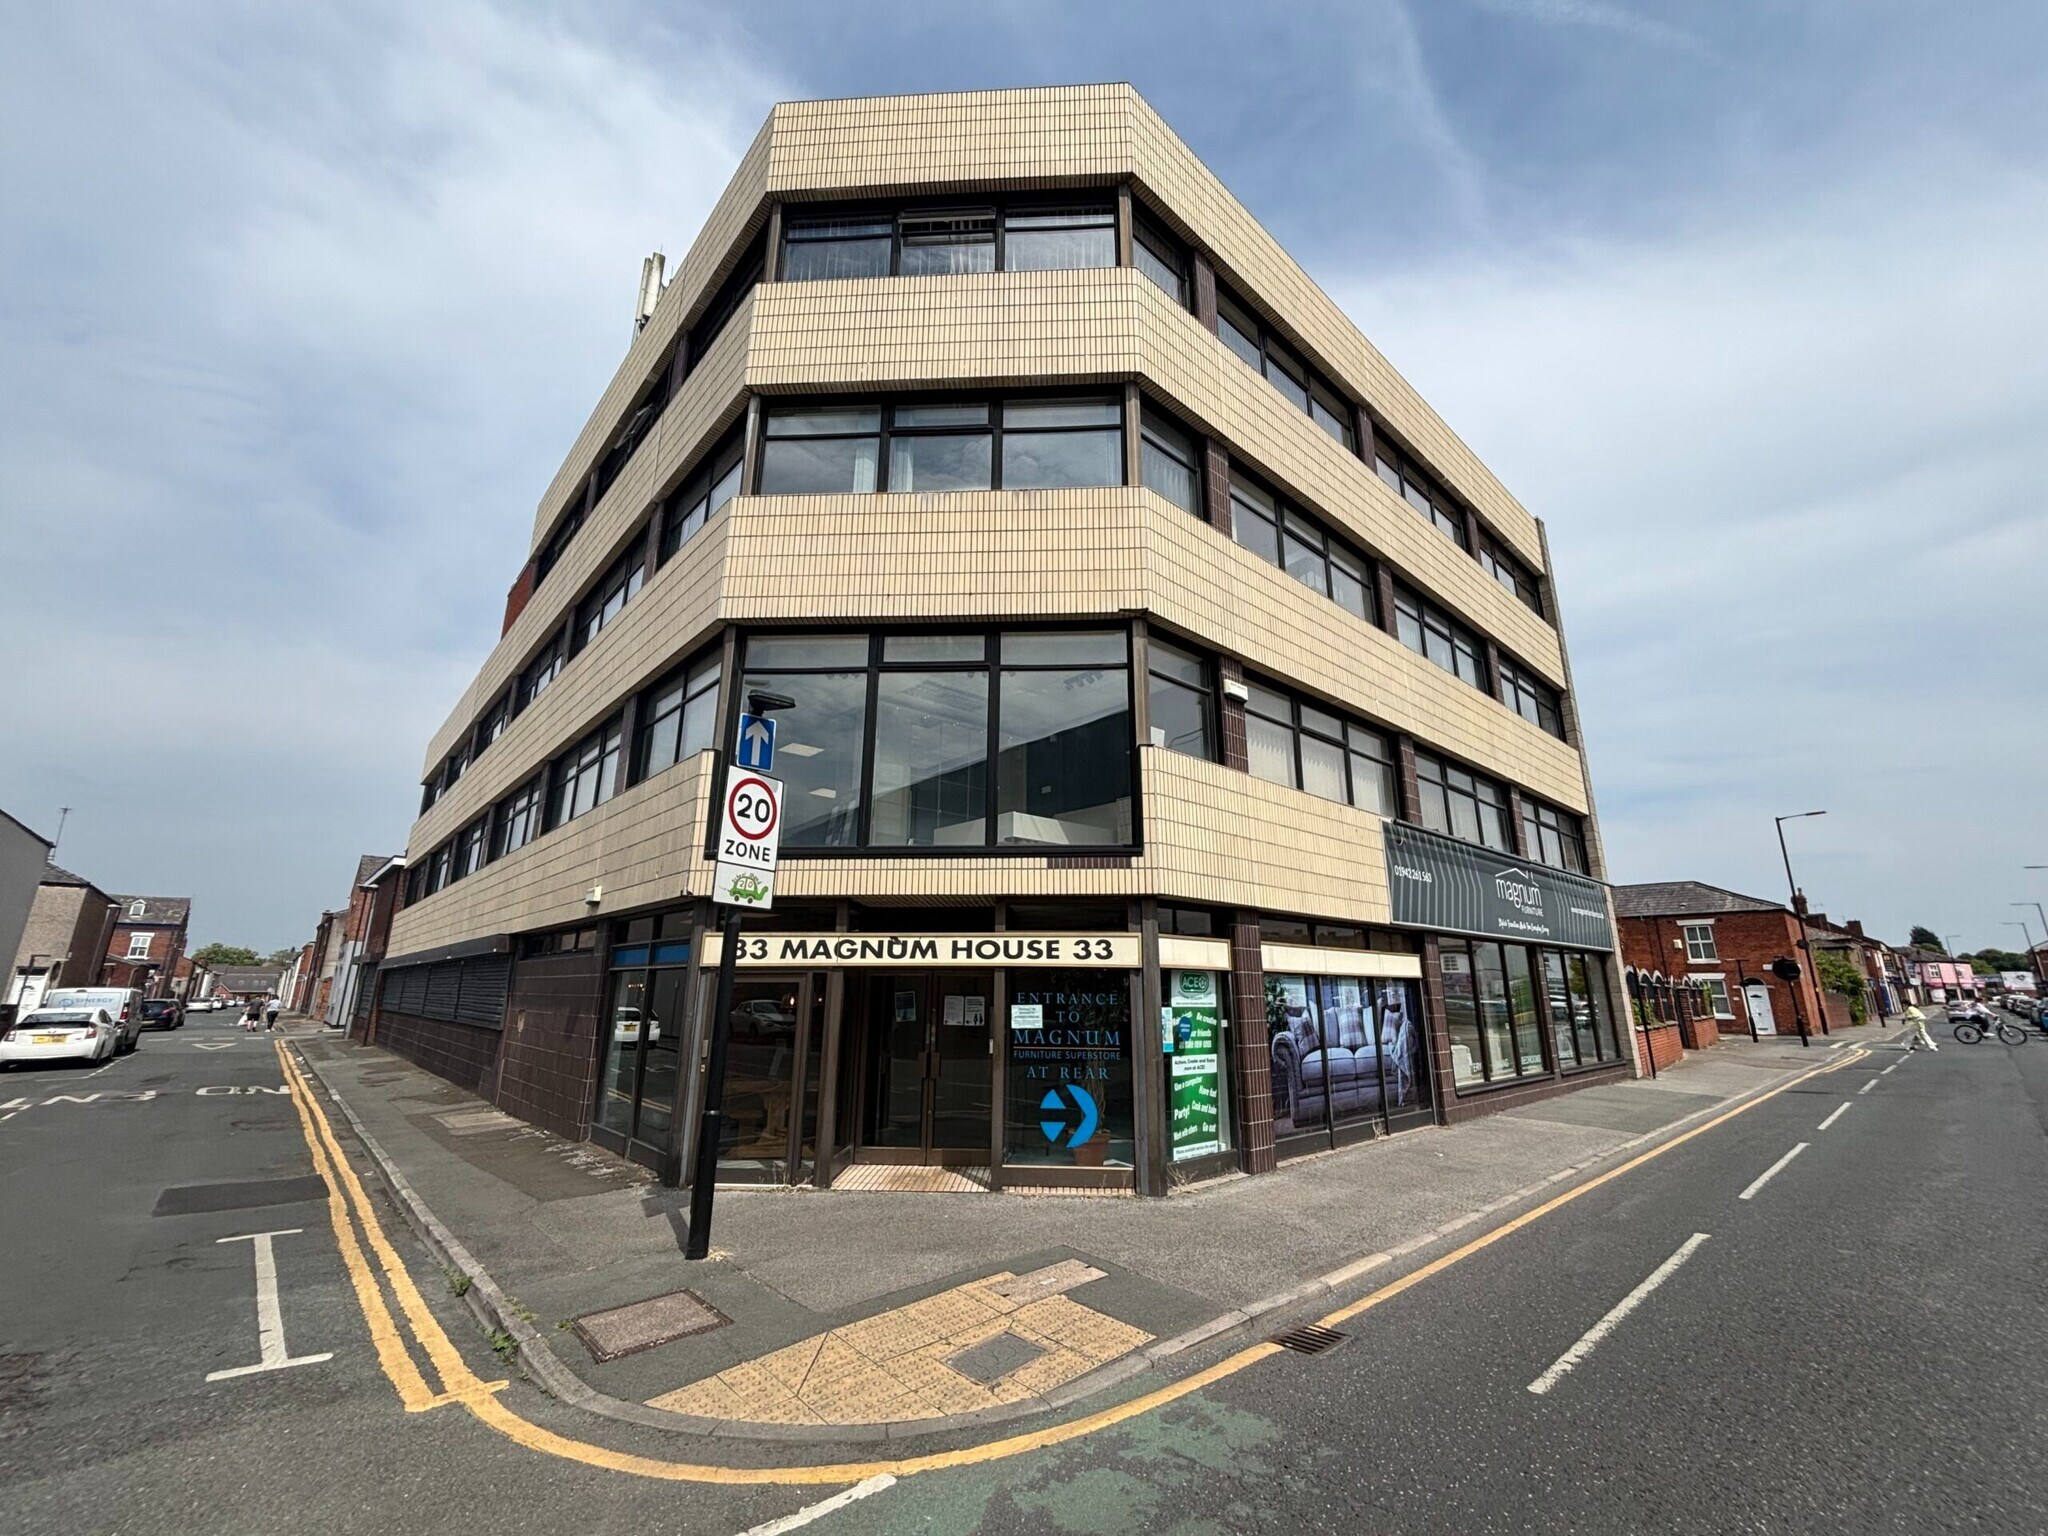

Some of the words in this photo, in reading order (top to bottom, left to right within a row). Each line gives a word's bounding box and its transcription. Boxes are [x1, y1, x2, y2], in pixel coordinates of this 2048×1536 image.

[737, 793, 770, 823] 20
[725, 839, 771, 862] ZONE
[1496, 879, 1542, 908] magnum
[780, 938, 938, 960] MAGNUM
[951, 939, 1060, 960] HOUSE
[1073, 939, 1114, 960] 33
[1017, 992, 1118, 1005] ENTRANCE
[1055, 1010, 1080, 1023] TO
[1013, 1029, 1120, 1046] MAGNUM
[1013, 1050, 1062, 1059] FURNITURE
[1065, 1051, 1120, 1060] SUPERSTORE
[1027, 1066, 1048, 1078] AT
[1060, 1066, 1109, 1079] REAR
